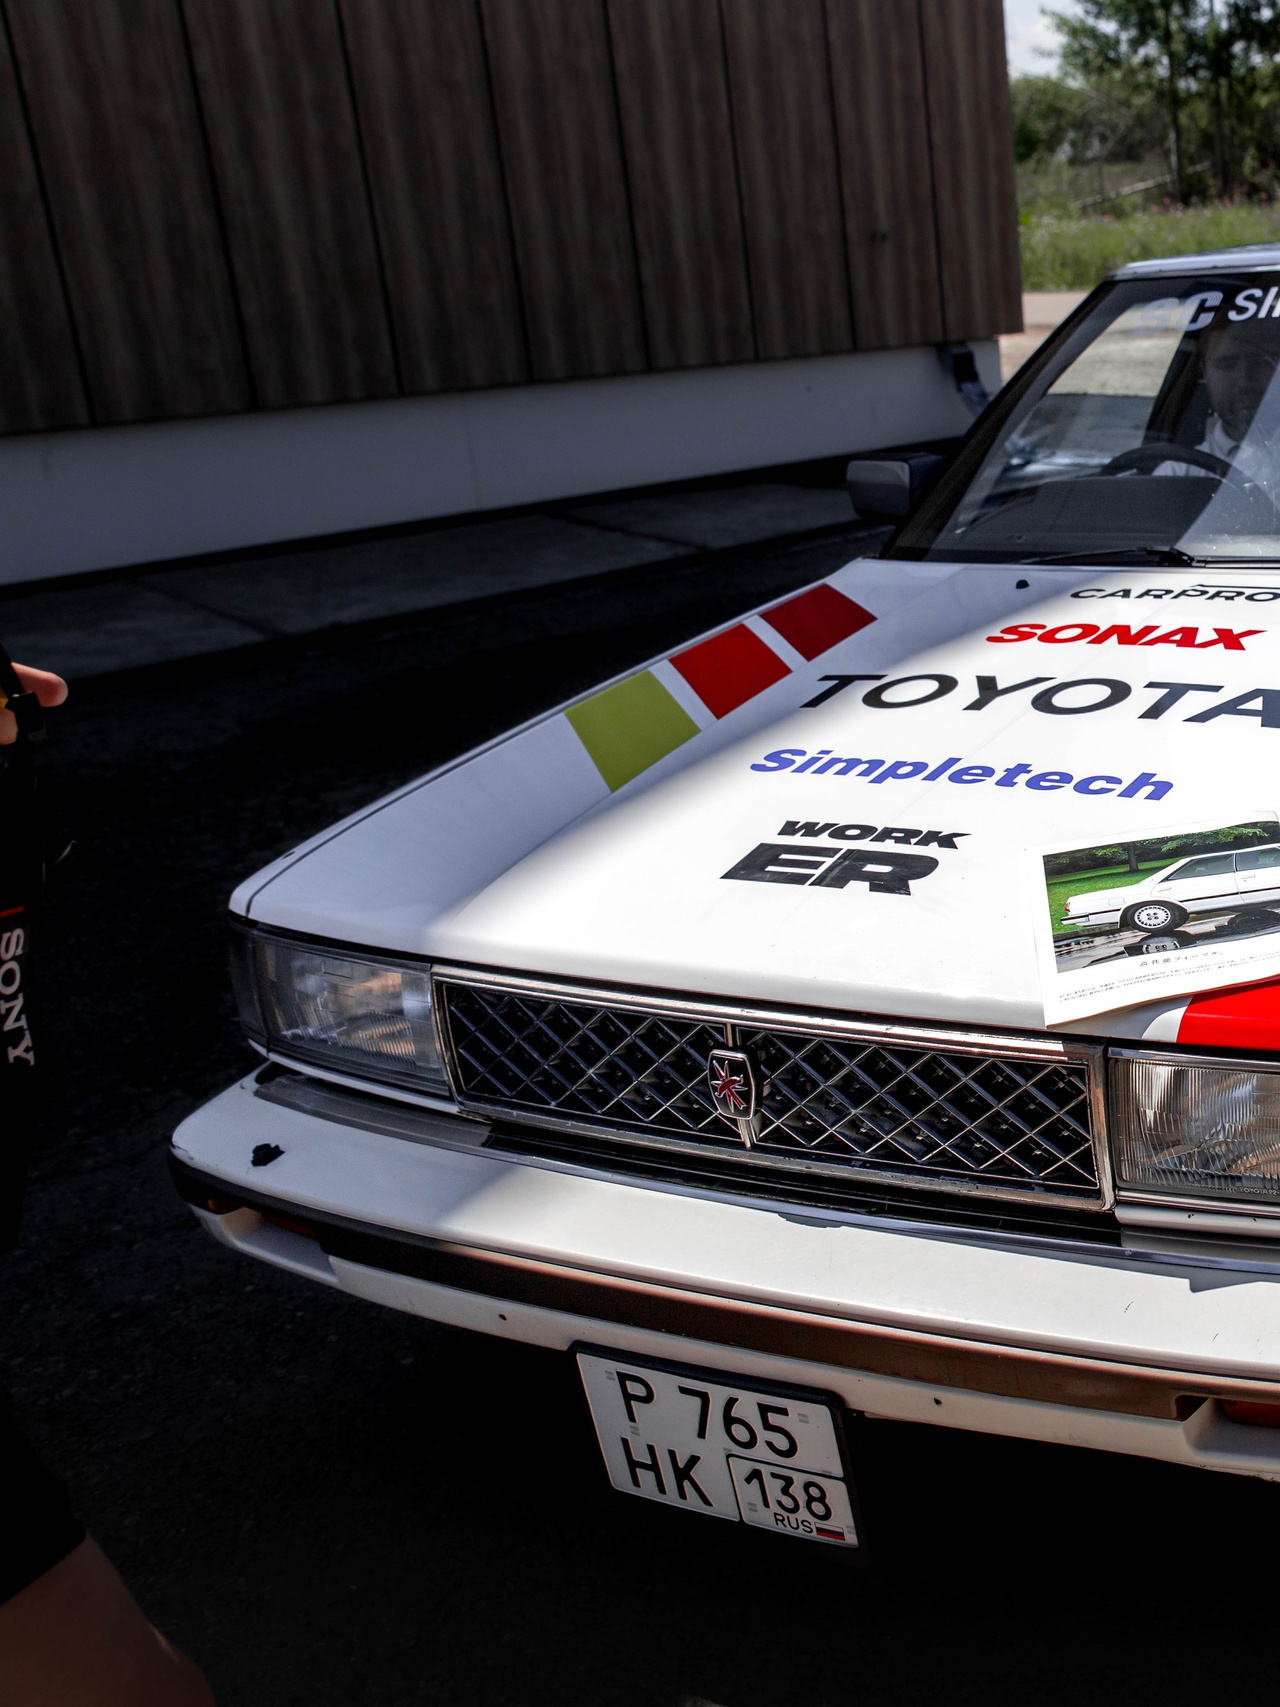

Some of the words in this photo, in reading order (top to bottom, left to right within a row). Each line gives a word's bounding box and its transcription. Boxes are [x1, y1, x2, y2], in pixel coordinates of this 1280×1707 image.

[986, 623, 1269, 651] SONAX
[750, 748, 1175, 801] Simpletech
[776, 820, 972, 849] WORK
[719, 842, 940, 896] ER
[0, 927, 35, 1066] SONY
[615, 1370, 655, 1424] P
[677, 1384, 799, 1459] 765
[620, 1436, 714, 1508] HK
[743, 1467, 832, 1522] 138
[773, 1512, 814, 1534] RUS
